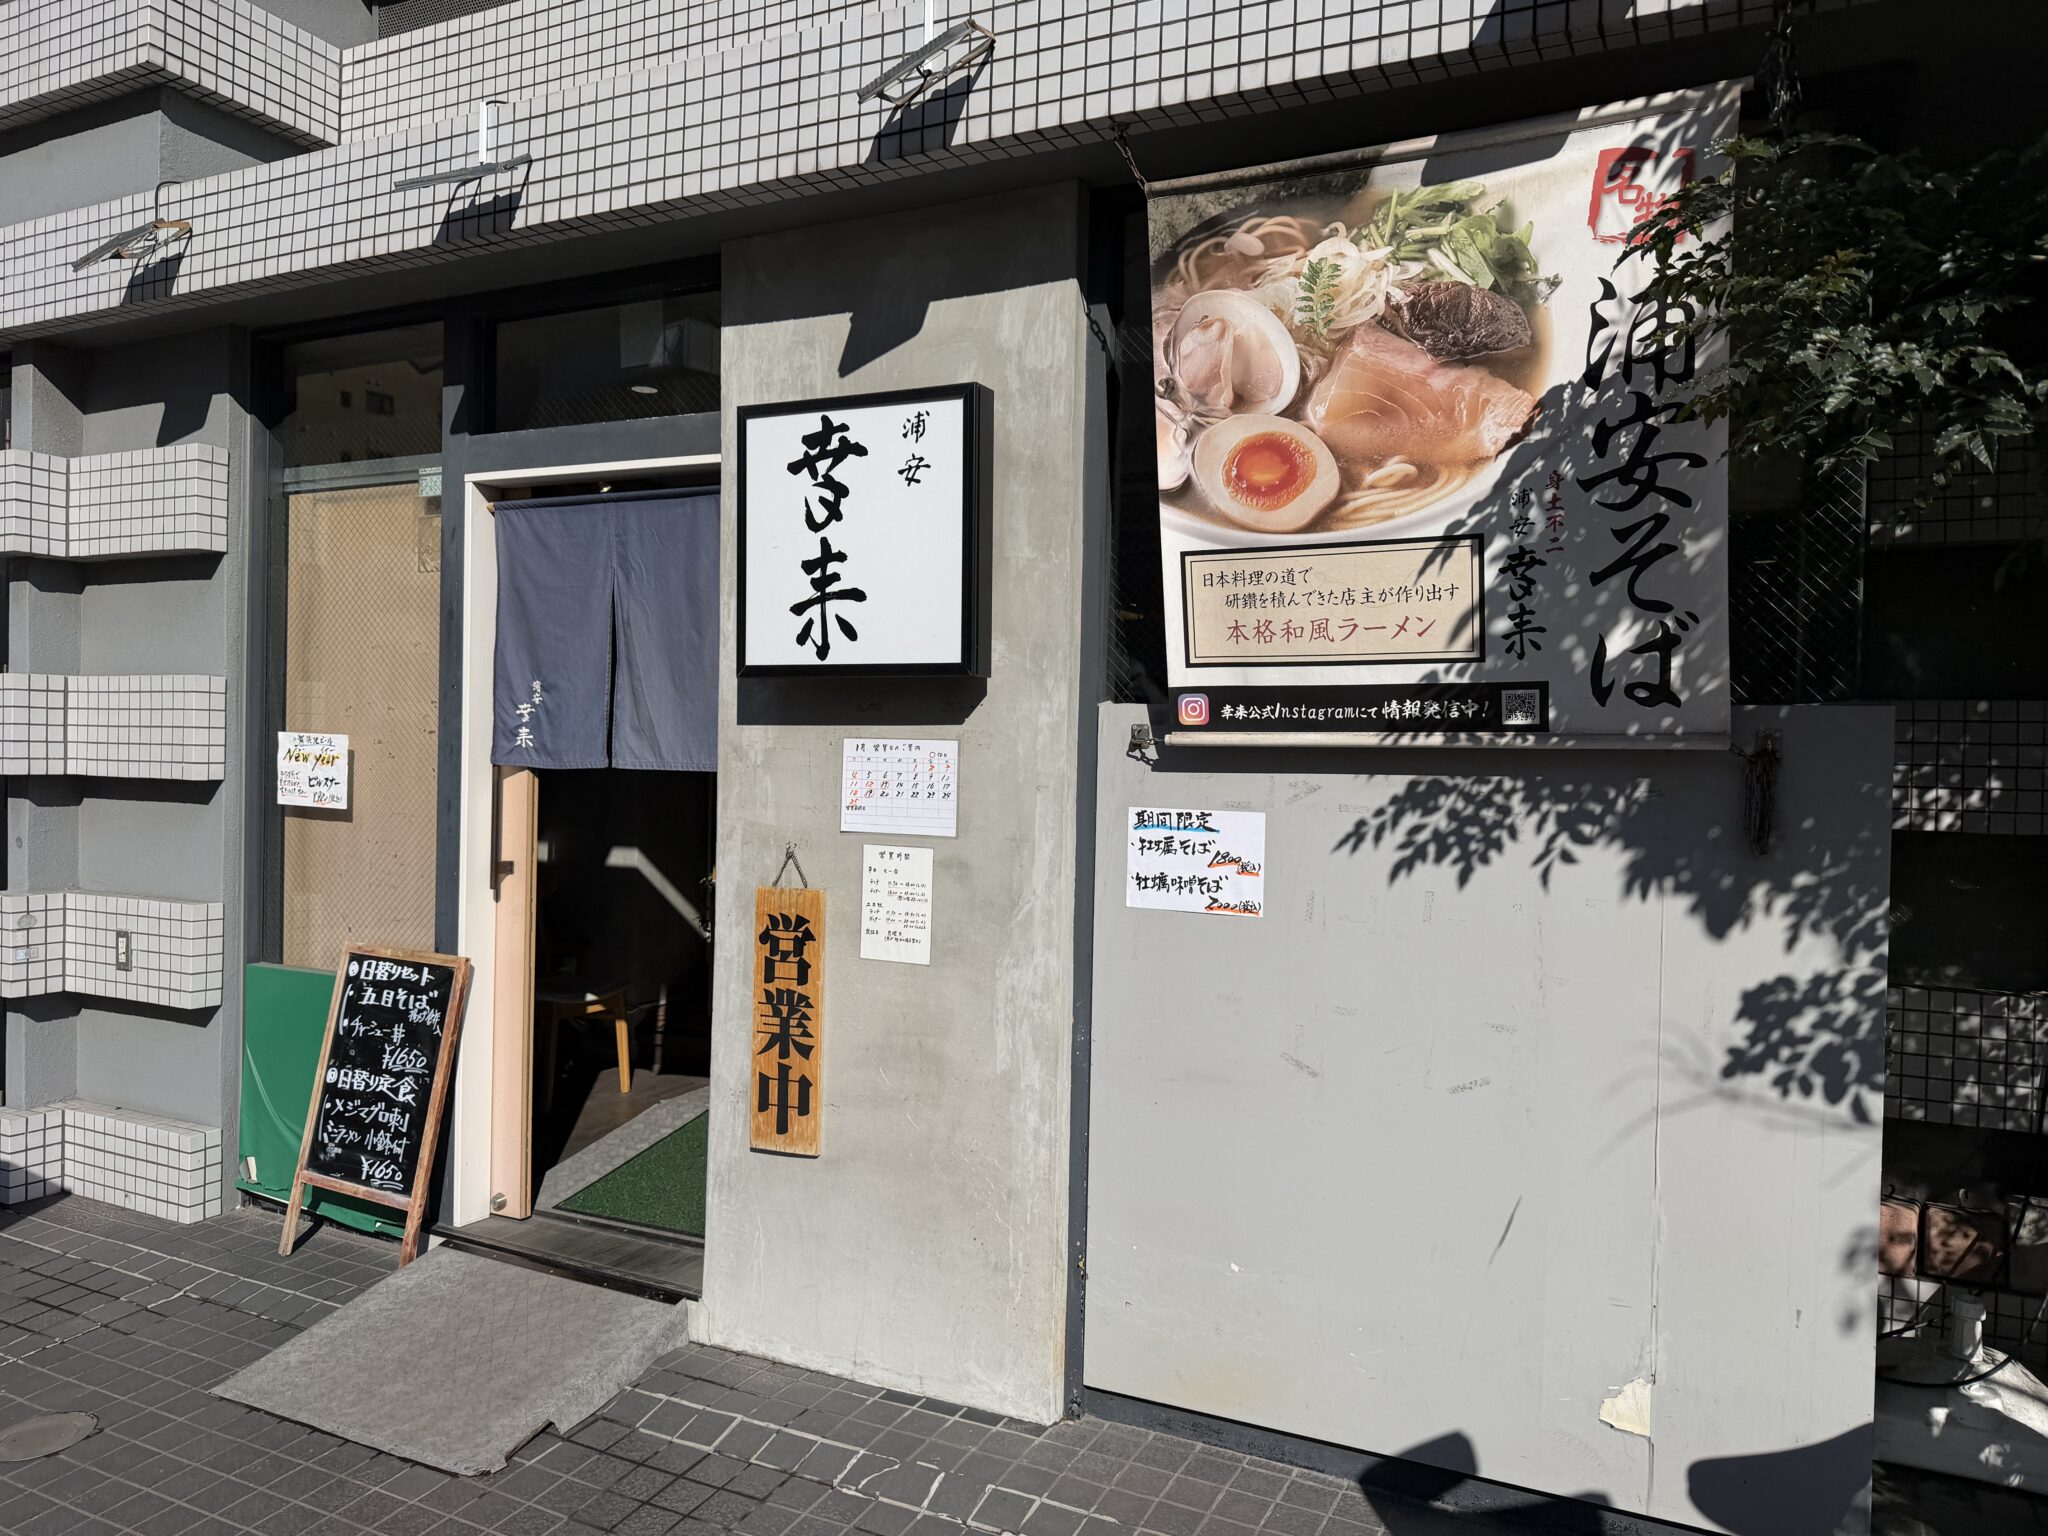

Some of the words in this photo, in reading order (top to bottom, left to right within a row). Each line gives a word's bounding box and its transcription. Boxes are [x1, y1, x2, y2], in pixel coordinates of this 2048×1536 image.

[897, 410, 932, 487] 浦安
[1576, 276, 1707, 709] 浦安そば
[1509, 487, 1535, 537] 浦安
[1545, 469, 1565, 553] 身土不二
[1203, 567, 1313, 588] 日本料理の道で
[1224, 583, 1460, 609] 研鑽を積んできた店主が作り出す
[1226, 615, 1437, 645] 本格和風ラーメン
[283, 748, 309, 763] New
[308, 776, 340, 791] ピルスナー
[1134, 810, 1220, 832] 期間限定
[1138, 836, 1216, 856] 牡蠣そば
[1135, 872, 1228, 895] 牡蠣味噌そば
[360, 960, 435, 986] 日替りセット
[357, 987, 438, 1010] 五目そば
[756, 912, 817, 1135] 営業中
[382, 1043, 427, 1069] ¥1650
[337, 1068, 419, 1106] 日替り定食
[331, 1099, 410, 1132] メジマグロ刺
[360, 1155, 403, 1180] ¥1650
